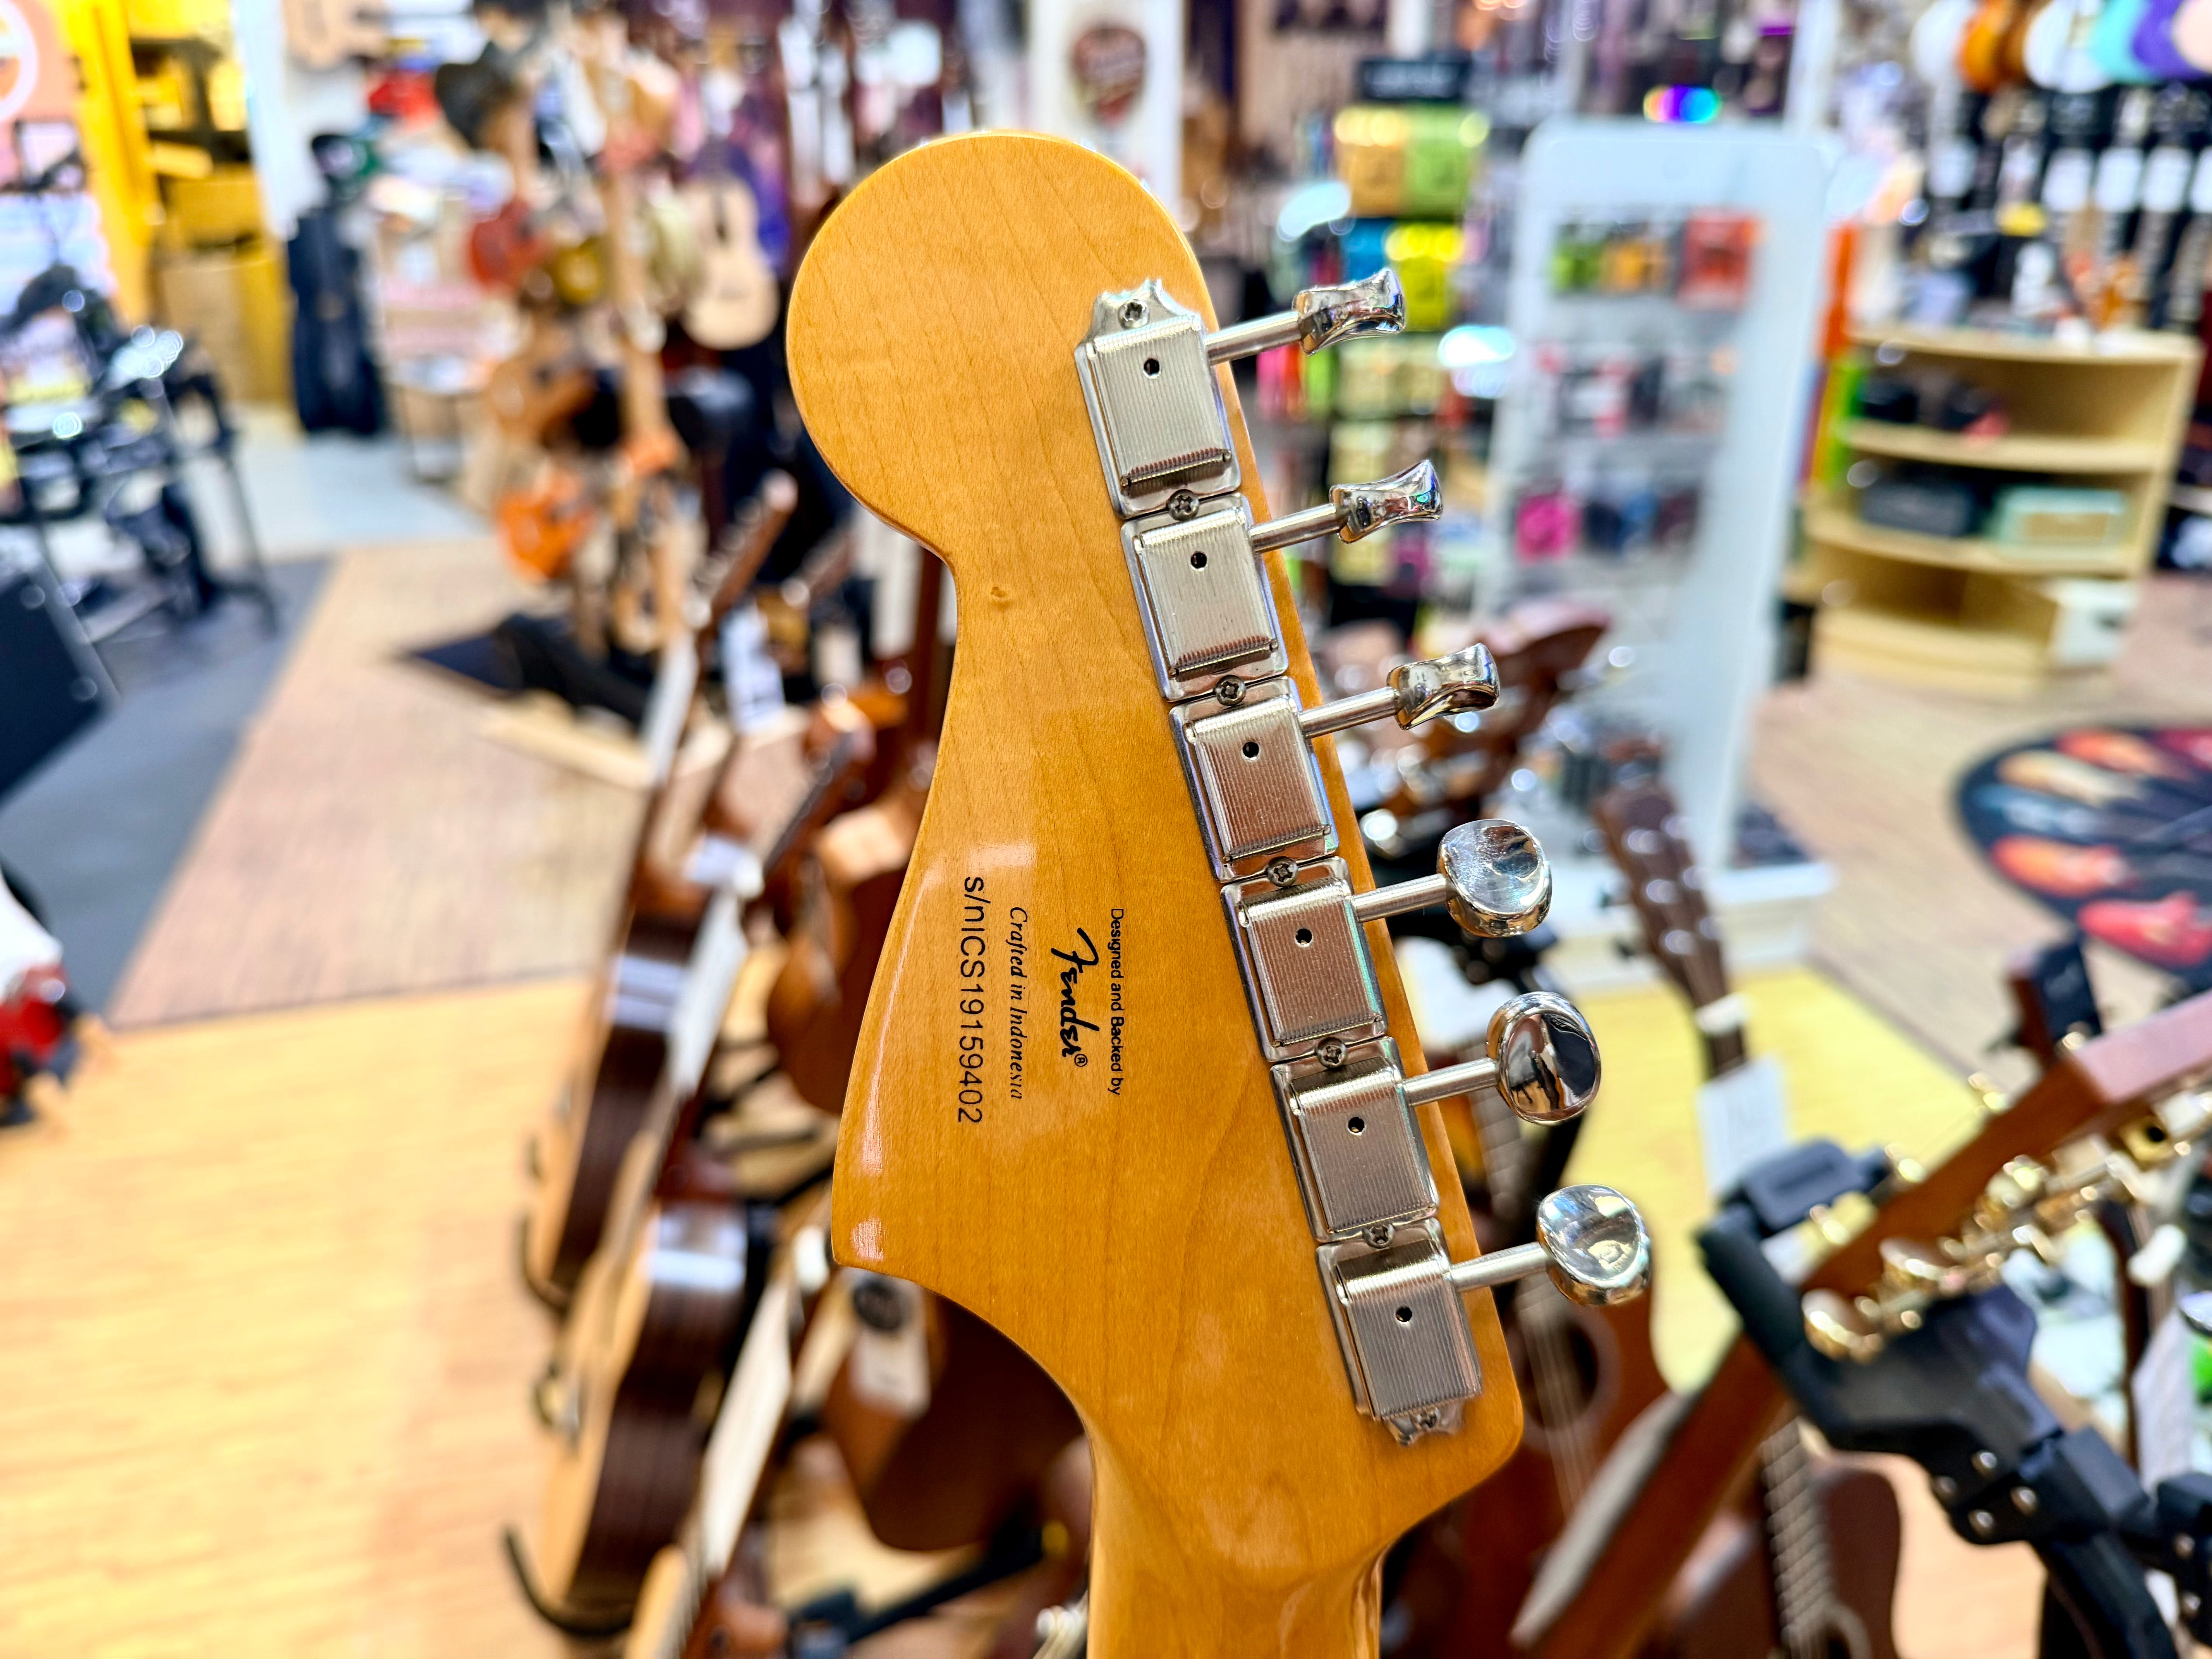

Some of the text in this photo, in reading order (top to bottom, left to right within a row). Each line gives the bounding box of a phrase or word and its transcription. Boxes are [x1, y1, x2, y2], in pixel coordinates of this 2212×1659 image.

[1006, 907, 1027, 1099] Crafted in Indonesia
[1108, 909, 1124, 1095] Designed and Backed by
